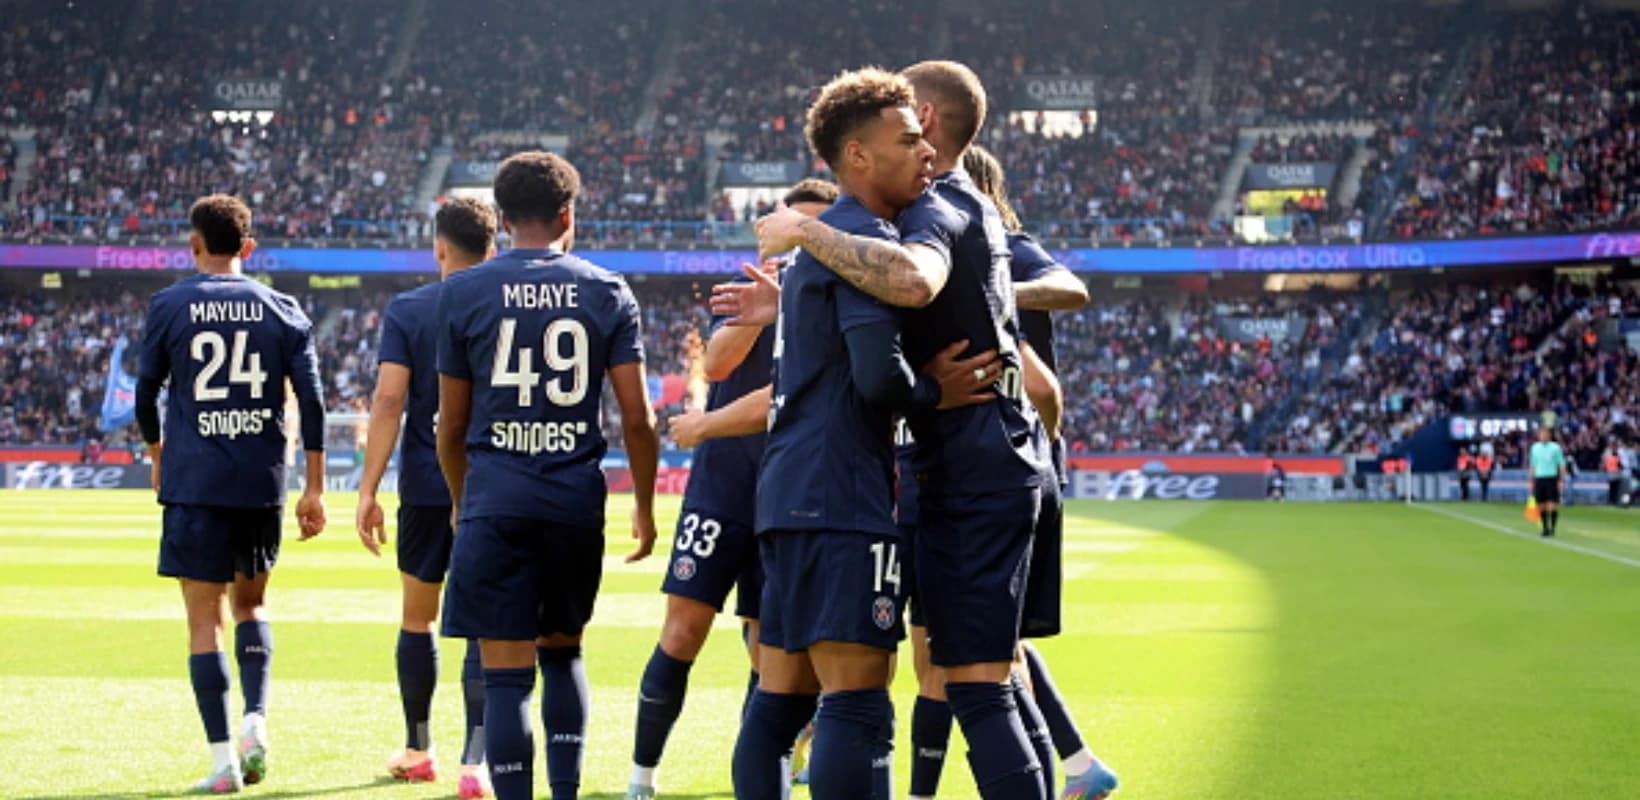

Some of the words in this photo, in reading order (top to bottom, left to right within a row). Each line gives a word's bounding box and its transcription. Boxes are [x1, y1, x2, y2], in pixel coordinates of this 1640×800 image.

[215, 81, 281, 102] QATAR
[96, 247, 195, 269] Freebo
[1238, 248, 1348, 271] Freebox
[1365, 245, 1425, 268] Ultra
[503, 283, 579, 309] MBAYE
[189, 301, 264, 323] MAYULU
[190, 330, 268, 402] 24
[490, 317, 590, 407] 49
[198, 407, 272, 440] snipes
[490, 420, 588, 456] snipes
[14, 461, 125, 490] free
[1105, 469, 1220, 500] free
[676, 512, 722, 558] 33
[869, 541, 901, 596] 14
